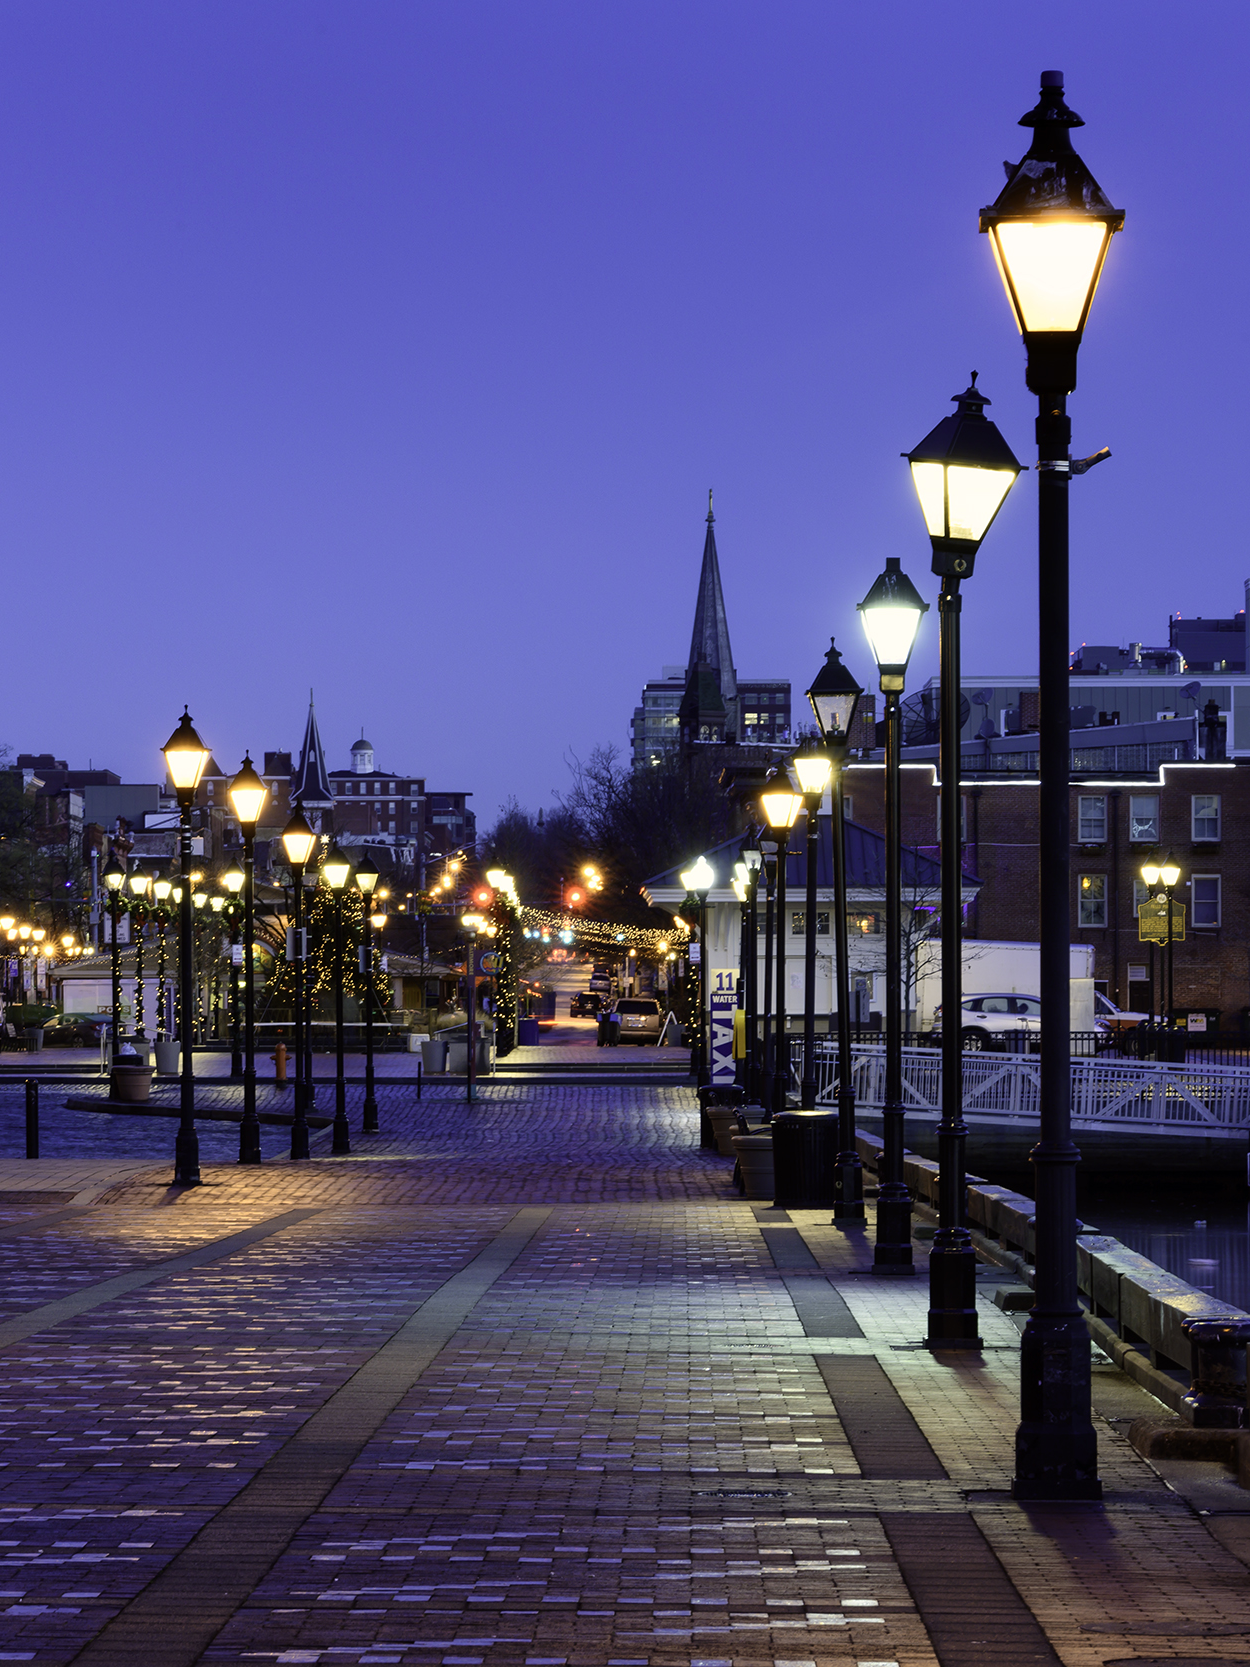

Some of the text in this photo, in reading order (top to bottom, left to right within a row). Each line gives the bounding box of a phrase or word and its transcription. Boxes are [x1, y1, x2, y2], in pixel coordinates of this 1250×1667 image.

[716, 972, 735, 991] 11
[712, 995, 738, 1003] WATER
[98, 1006, 130, 1014] POS
[712, 1004, 738, 1084] TAXI
